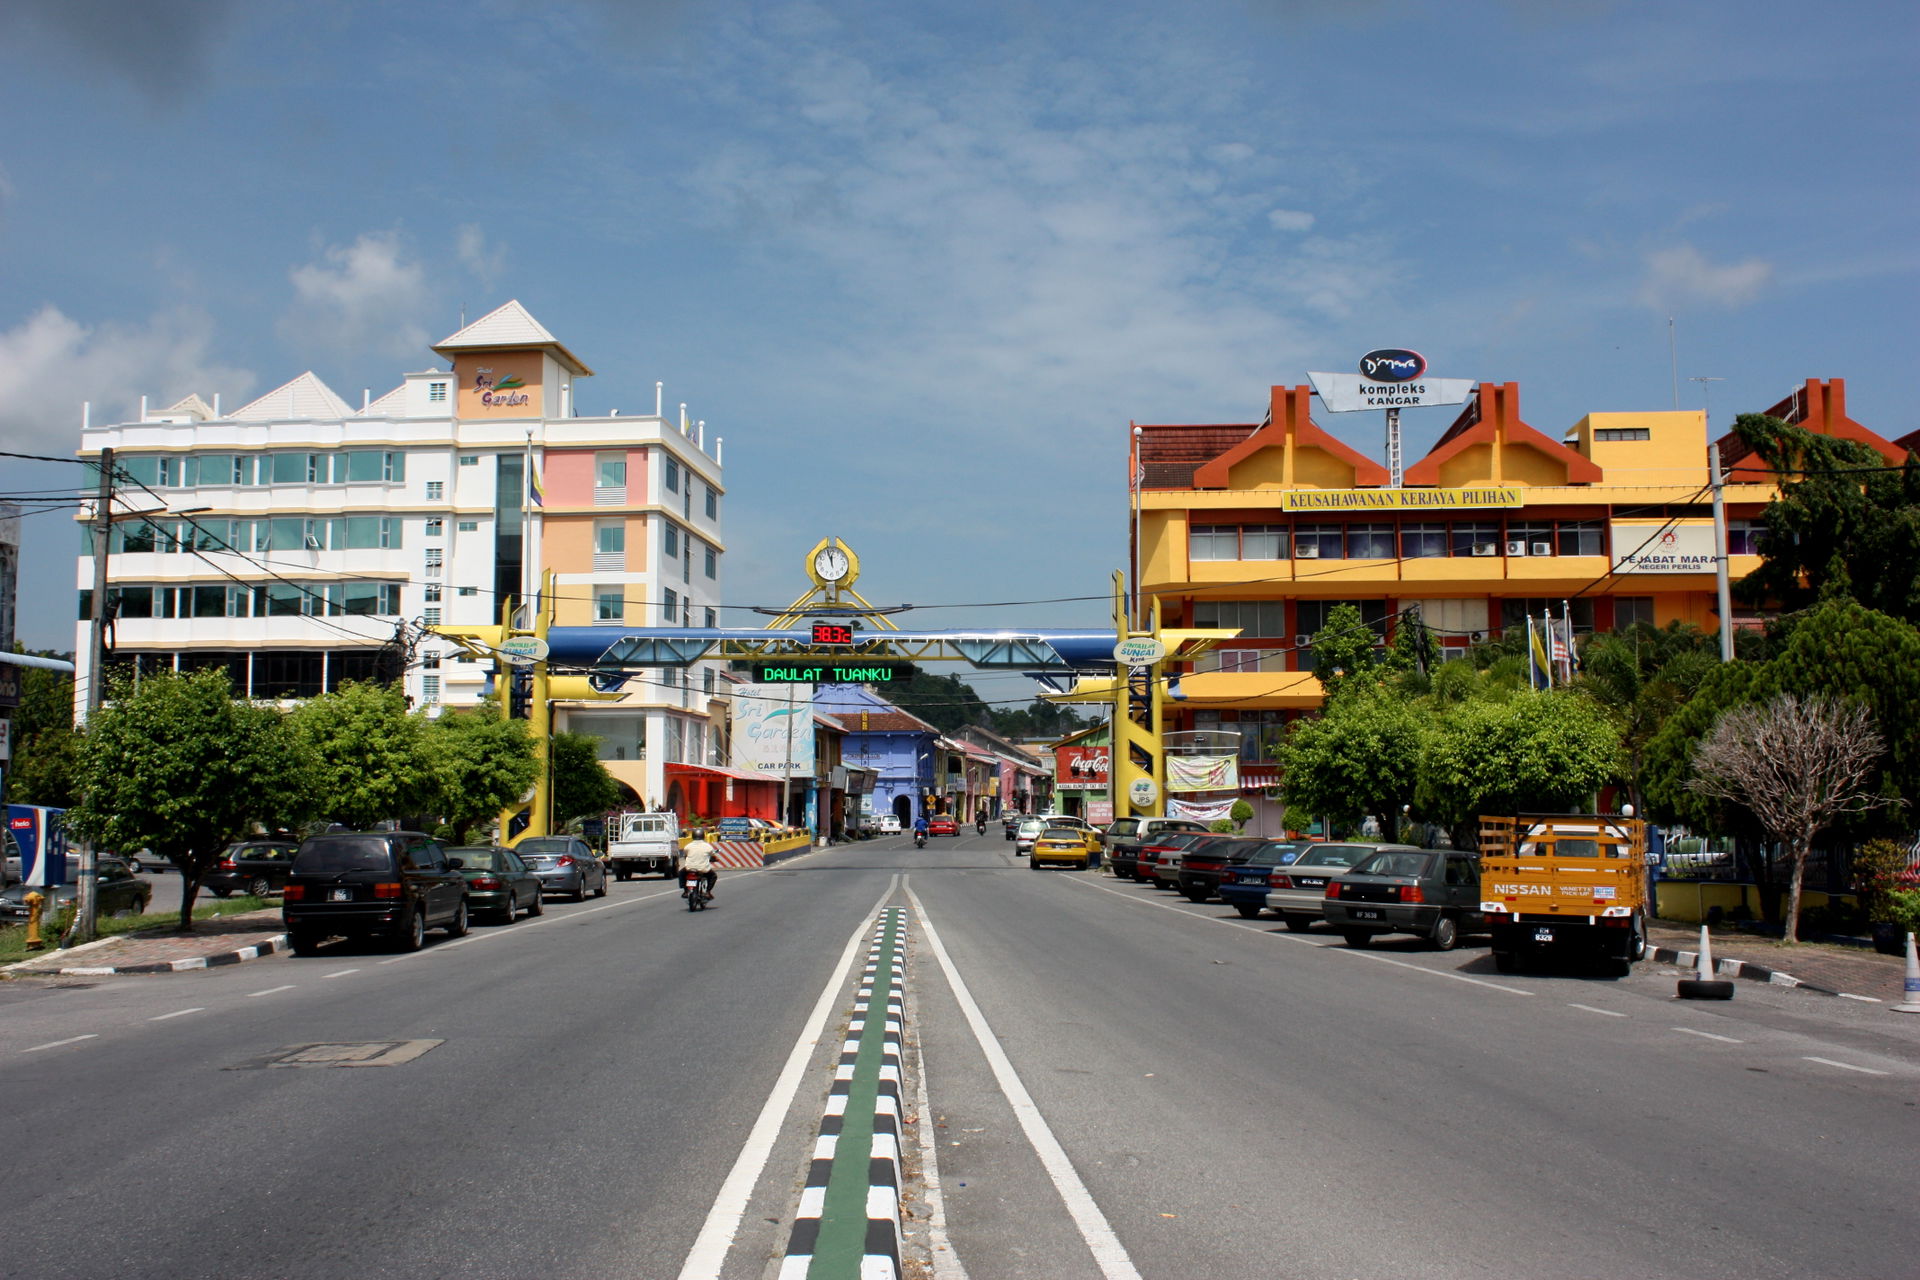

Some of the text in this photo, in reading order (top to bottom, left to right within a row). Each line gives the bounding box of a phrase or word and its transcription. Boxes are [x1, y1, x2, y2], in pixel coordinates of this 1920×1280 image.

[1359, 383, 1426, 396] kompleks
[482, 391, 529, 407] Garden
[1367, 397, 1420, 405] KANGAR
[1289, 490, 1516, 508] KEUSAHAWANAN KERJAYA PILIHAN
[1621, 556, 1718, 564] PEJABAT MARA
[764, 668, 892, 681] DAULAT TUANKU
[739, 687, 762, 697] Hotel
[736, 699, 763, 720] Sri
[1071, 756, 1109, 772] Coca-Col
[1494, 884, 1551, 895] NISSAN
